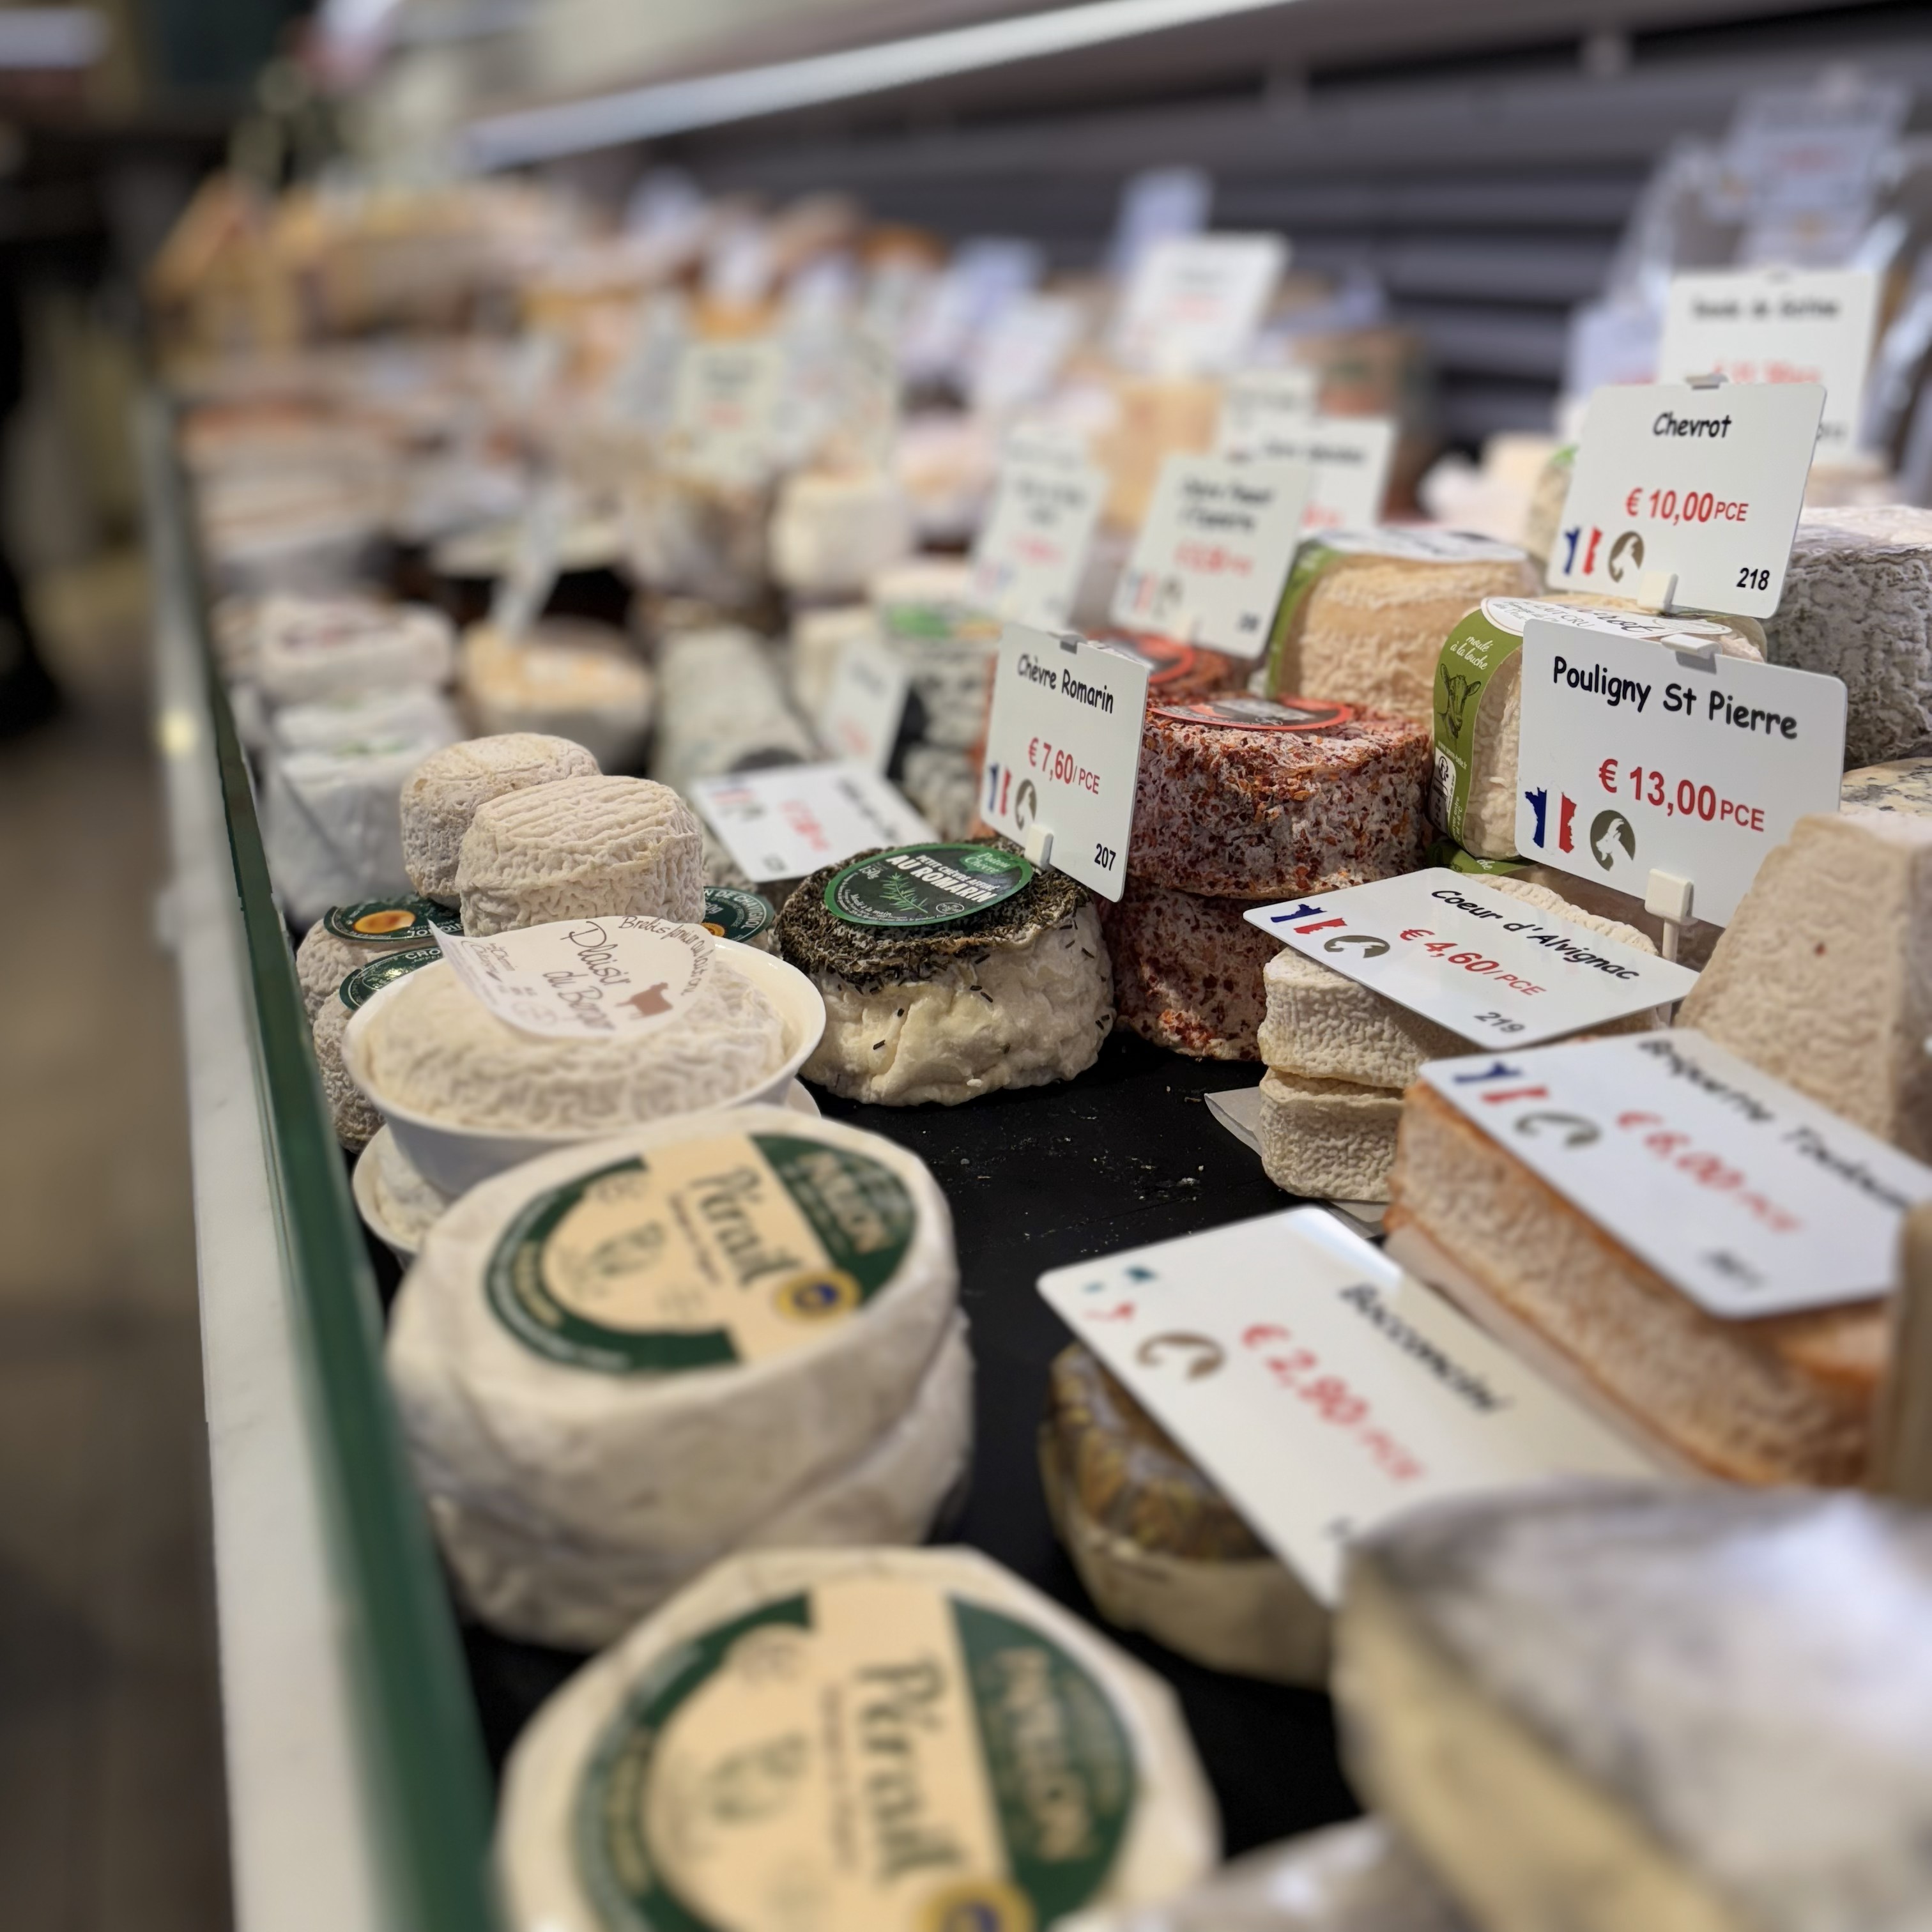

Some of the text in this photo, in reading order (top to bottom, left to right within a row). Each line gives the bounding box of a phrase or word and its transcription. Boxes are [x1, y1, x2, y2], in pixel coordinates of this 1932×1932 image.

[1653, 411, 1732, 438] Chevrot
[1736, 567, 1771, 591] 218
[1561, 615, 1595, 627] CRU
[1450, 641, 1488, 670] à la louche
[1466, 636, 1494, 652] moulé
[1017, 654, 1114, 714] Chèvre Romarin
[1553, 656, 1798, 740] Pouligny St Pierre
[916, 854, 942, 868] PETIT
[1094, 843, 1116, 871] 207
[885, 854, 998, 903] AU ROMARIN
[618, 916, 671, 934] Brebis
[733, 894, 763, 929] CHAVIGNOL
[1430, 890, 1640, 981] Coeur d'Alvignac
[542, 970, 589, 988] du
[1473, 1011, 1526, 1034] 219
